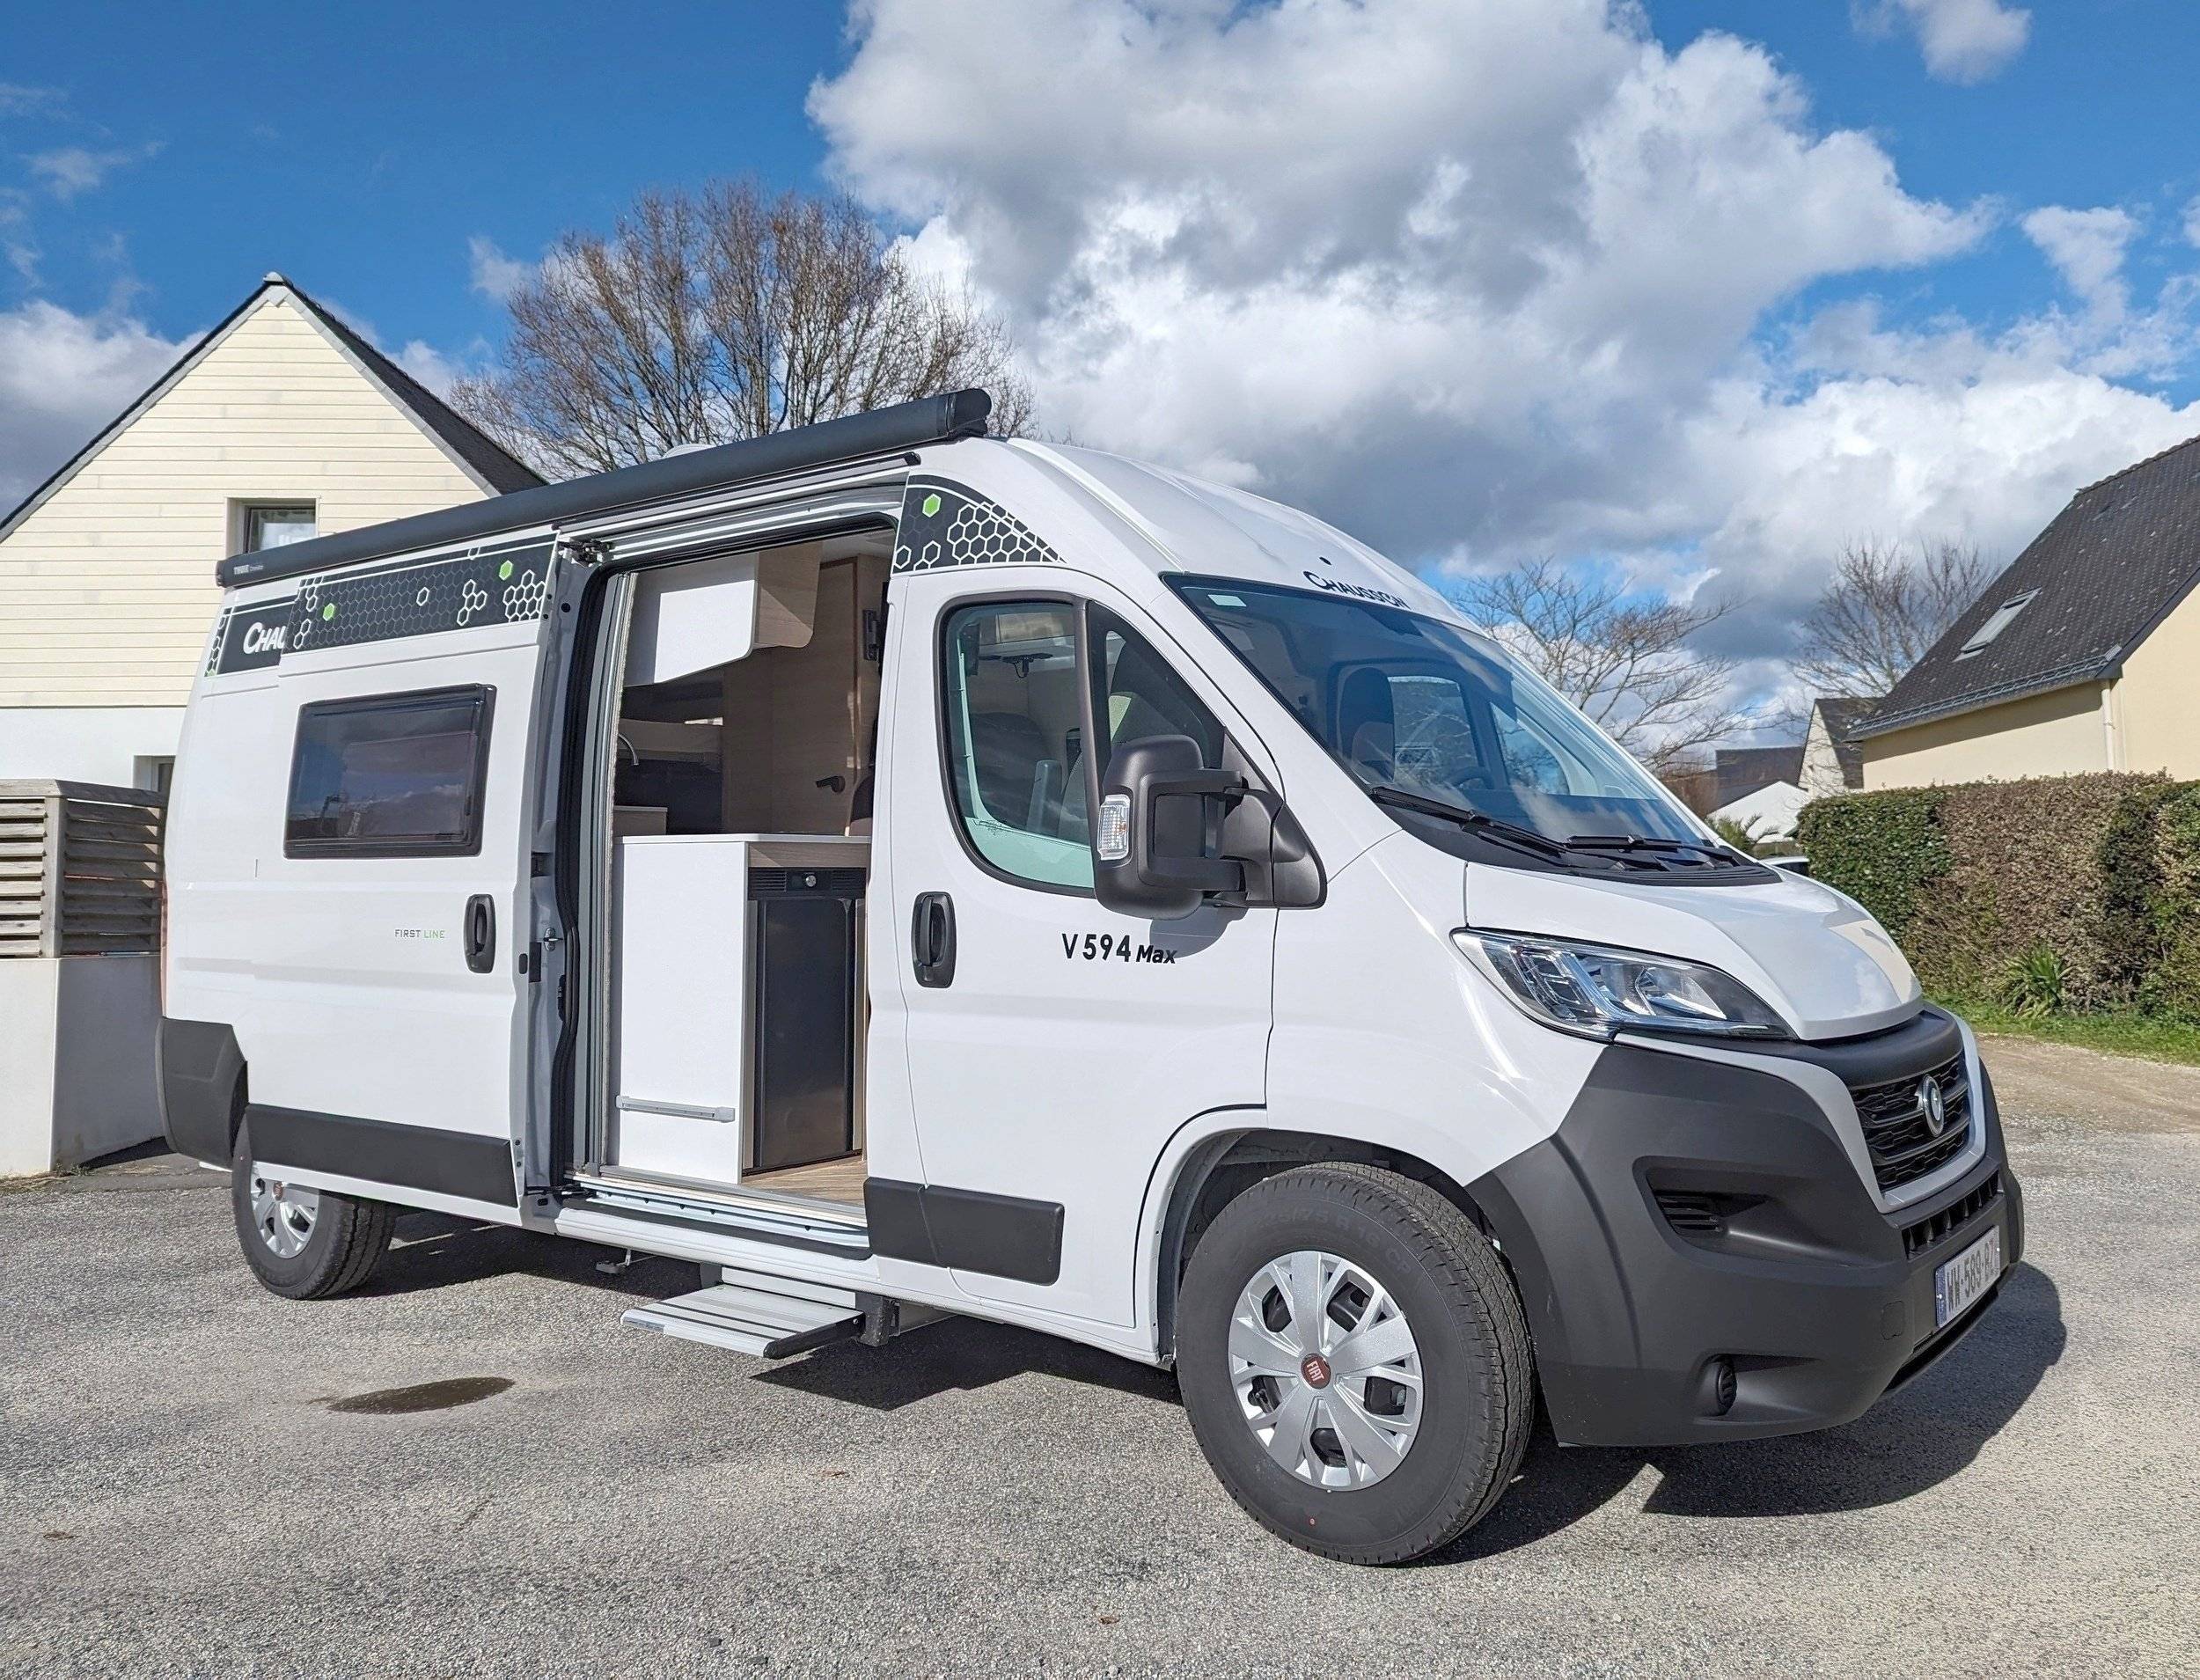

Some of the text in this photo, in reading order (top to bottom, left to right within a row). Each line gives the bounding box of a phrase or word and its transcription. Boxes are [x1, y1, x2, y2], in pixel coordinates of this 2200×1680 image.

[394, 928, 445, 939] FIRST LINE
[1135, 944, 1178, 965] Max
[1306, 1360, 1325, 1383] FIAT
